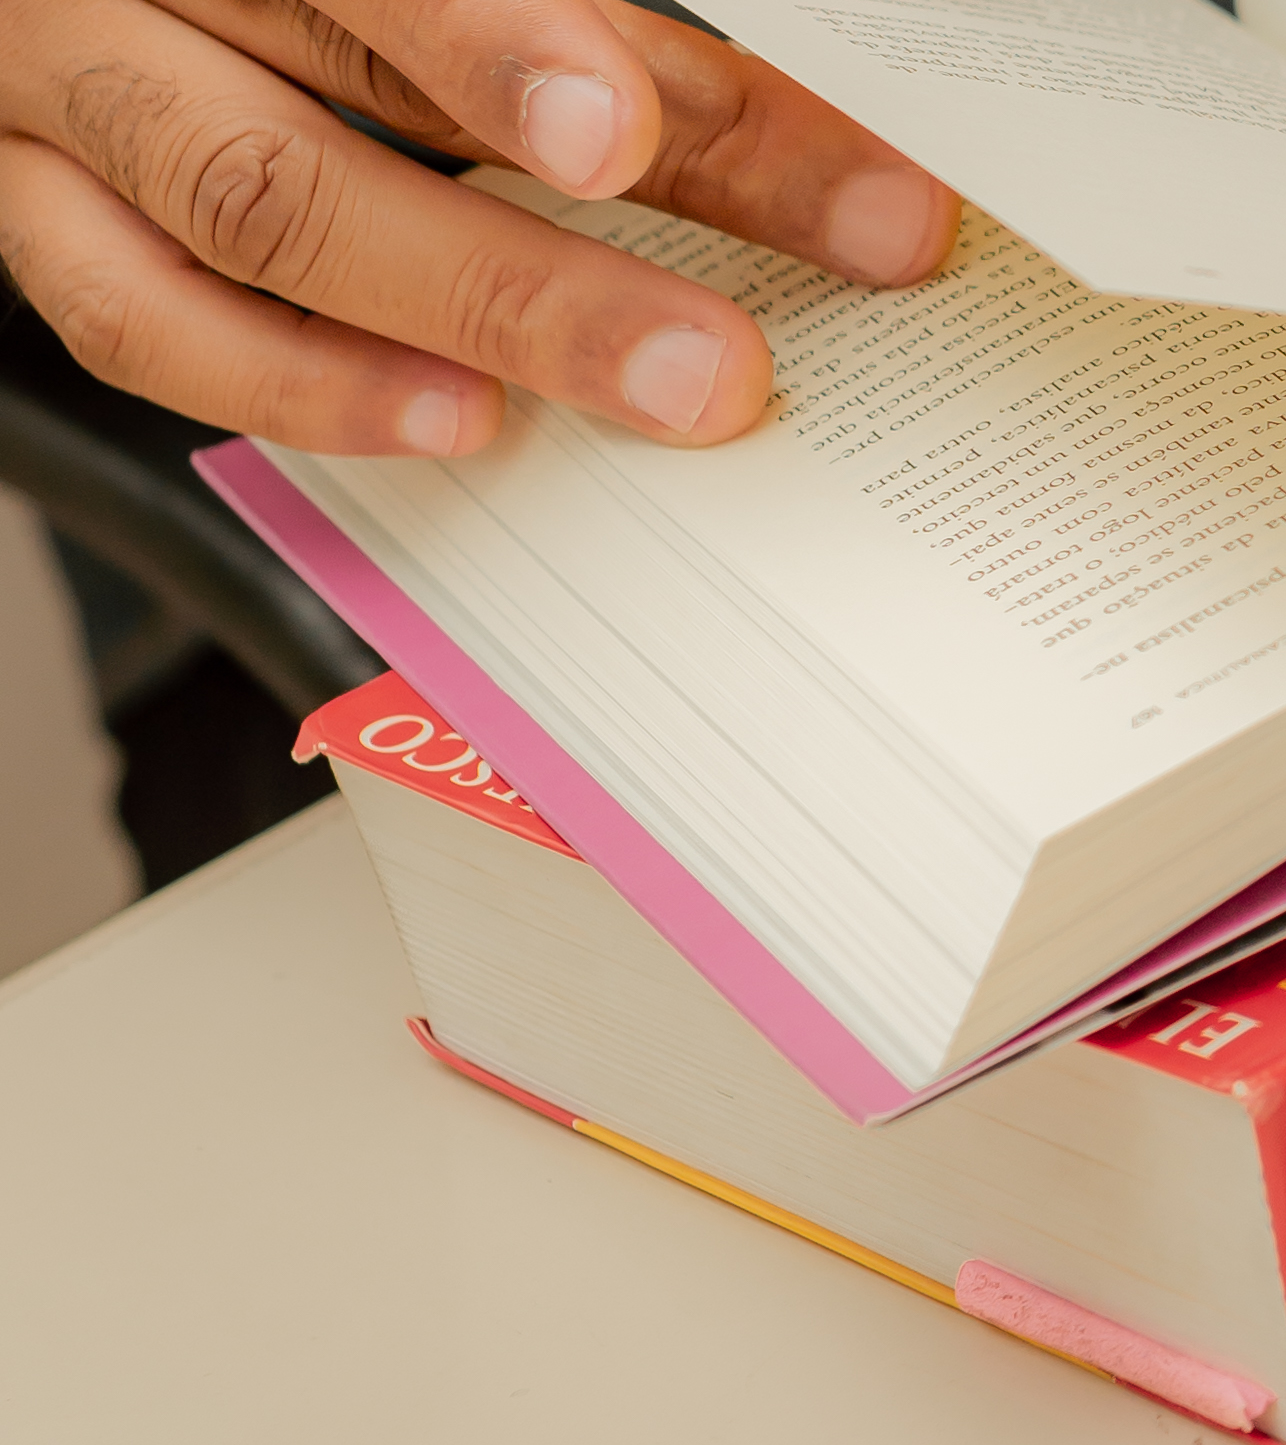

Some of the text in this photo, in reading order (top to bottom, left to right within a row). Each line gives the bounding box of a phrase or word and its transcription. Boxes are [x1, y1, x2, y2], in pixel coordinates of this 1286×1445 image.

[864, 292, 1100, 420] contratransferência
[828, 325, 1075, 465] esclarecimento pre-
[860, 310, 1209, 494] médico analista, outra para
[879, 319, 1244, 509] teoria psicanalítica, permite
[1131, 359, 1255, 417] recomeça
[896, 356, 1207, 523] ocorre, sabidamente
[1082, 419, 1175, 468] mesma
[1122, 415, 1234, 471] também
[1122, 437, 1238, 497] analítica
[911, 478, 1020, 534] terceiro,
[995, 471, 1076, 516] forma
[1154, 446, 1264, 508] paciente
[1224, 463, 1282, 497] pelo
[1020, 488, 1088, 528] sente
[1088, 507, 1153, 542] logo
[1108, 498, 1217, 557] médico;
[949, 527, 1015, 566] apai-
[966, 539, 1042, 582] outro
[982, 543, 1083, 601] tornará
[1003, 572, 1079, 613] trata-
[1020, 563, 1142, 627] separam,
[1102, 554, 1212, 614] situação
[1079, 651, 1129, 681] ne-
